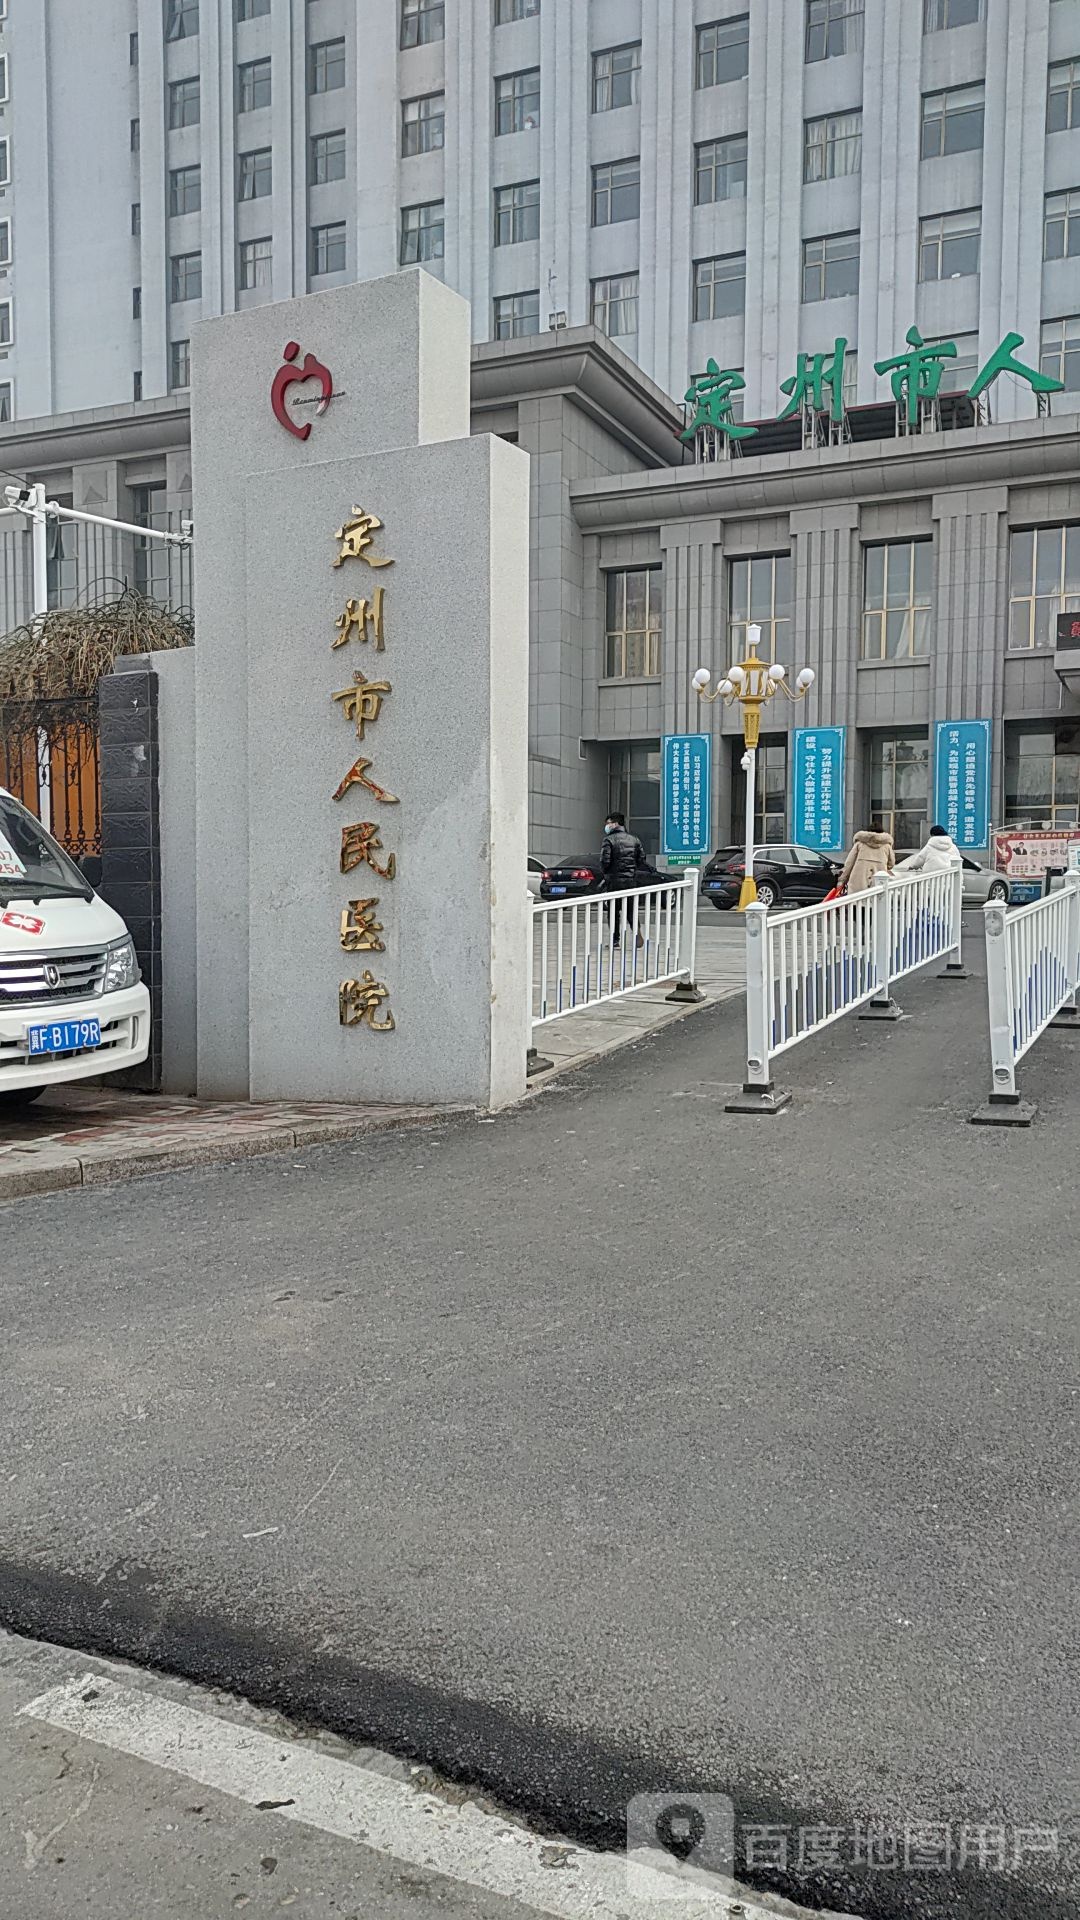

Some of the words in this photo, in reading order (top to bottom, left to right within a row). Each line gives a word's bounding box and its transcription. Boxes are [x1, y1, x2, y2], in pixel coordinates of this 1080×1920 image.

[680, 325, 1065, 440] 定州市人
[331, 503, 400, 1031] 定州市人民医院
